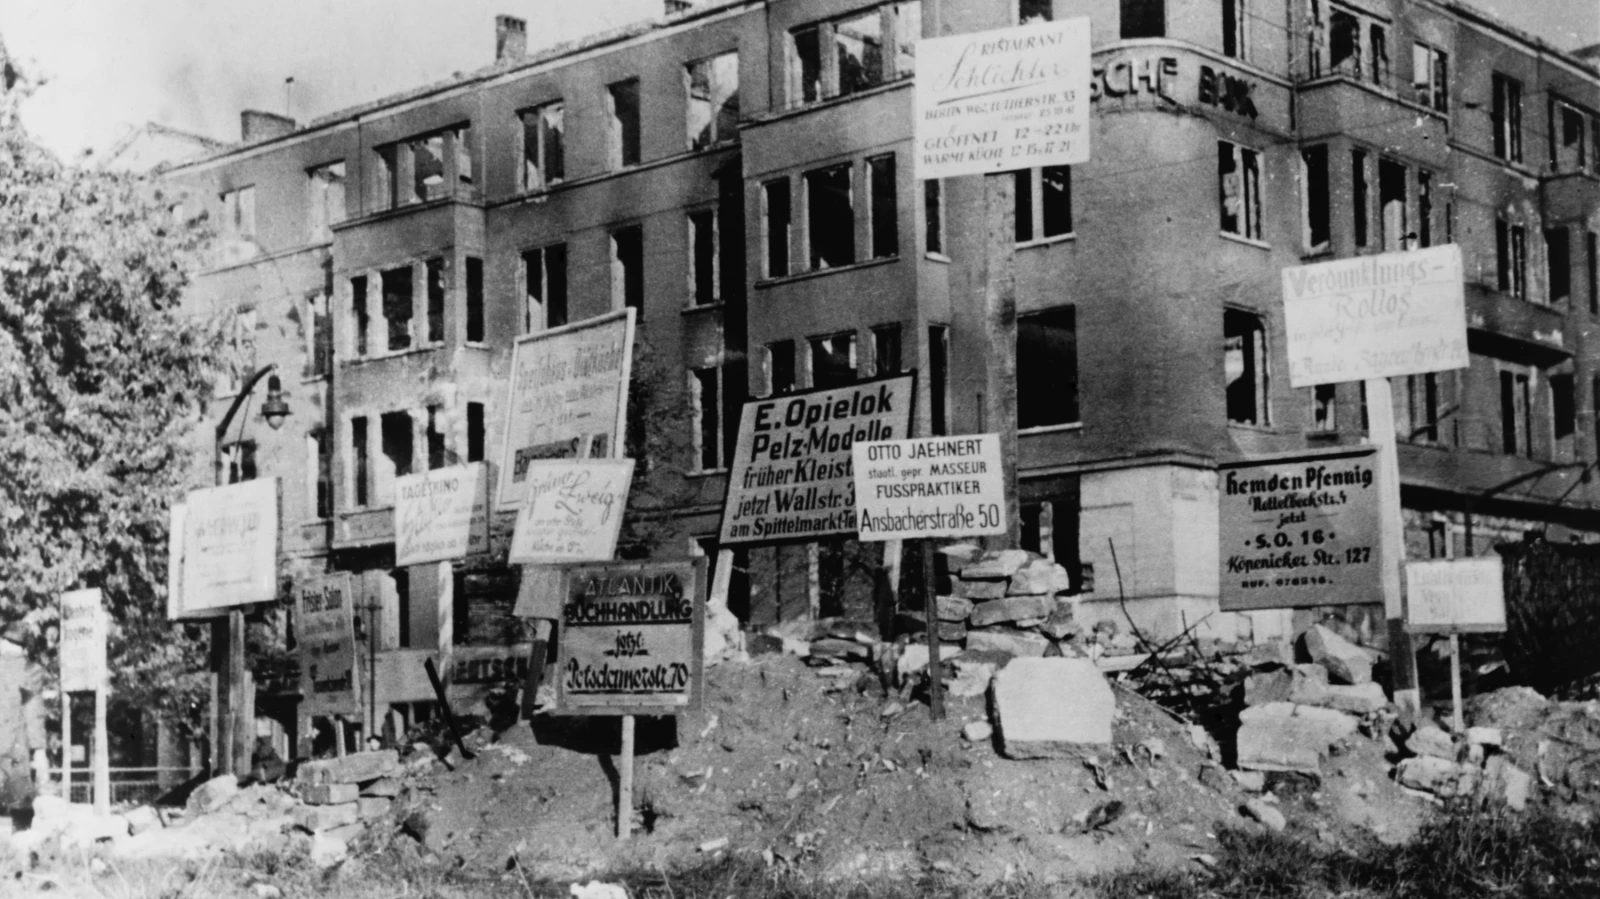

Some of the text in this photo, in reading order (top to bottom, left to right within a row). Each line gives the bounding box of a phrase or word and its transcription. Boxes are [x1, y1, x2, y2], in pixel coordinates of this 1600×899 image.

[981, 32, 1064, 56] RESTAURANT
[1329, 287, 1412, 320] Rollos
[785, 384, 894, 429] Opielok
[868, 439, 983, 461] OTTO JAEHNERT
[743, 464, 793, 489] früher
[930, 461, 987, 476] MASSEUR
[1306, 465, 1373, 490] Pfennig
[876, 480, 981, 499] FUSSPRAKTIKER
[733, 494, 771, 520] jetzt
[774, 486, 842, 514] Wallstr.
[860, 502, 1000, 533] Ansbacherstraße 50
[1276, 511, 1307, 529] jetzt
[730, 524, 750, 538] am
[1301, 529, 1325, 545] 16
[1345, 546, 1371, 564] 127
[585, 574, 674, 596] ATLANTIK
[564, 599, 693, 622] BUCHHANDLUNG
[670, 662, 690, 689] 70
